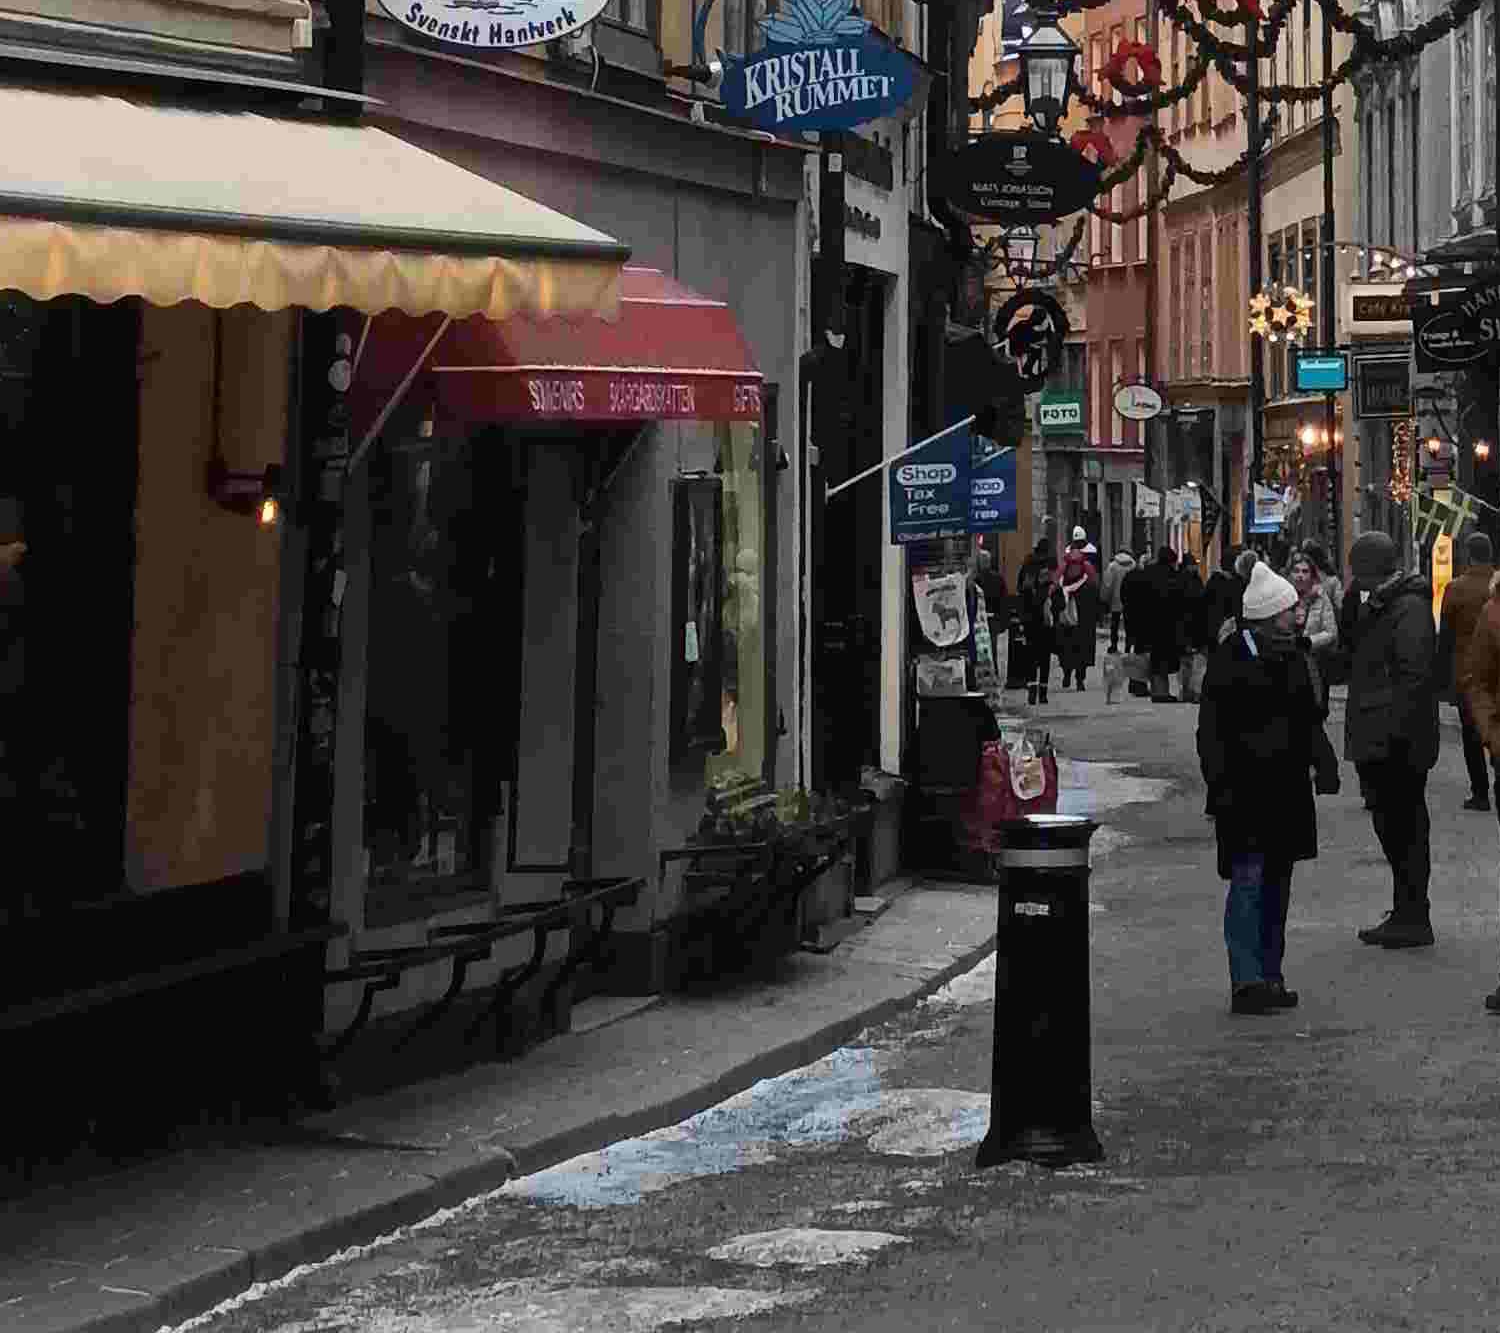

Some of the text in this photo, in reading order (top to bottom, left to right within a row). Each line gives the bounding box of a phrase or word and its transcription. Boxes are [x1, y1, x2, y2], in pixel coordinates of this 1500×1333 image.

[405, 3, 481, 45] Svenskt
[743, 48, 865, 110] KRISTALL
[774, 76, 891, 123] RUMMET
[1042, 407, 1078, 420] FOTO
[901, 466, 952, 484] Shop
[904, 487, 935, 500] Tax
[908, 502, 950, 516] Free
